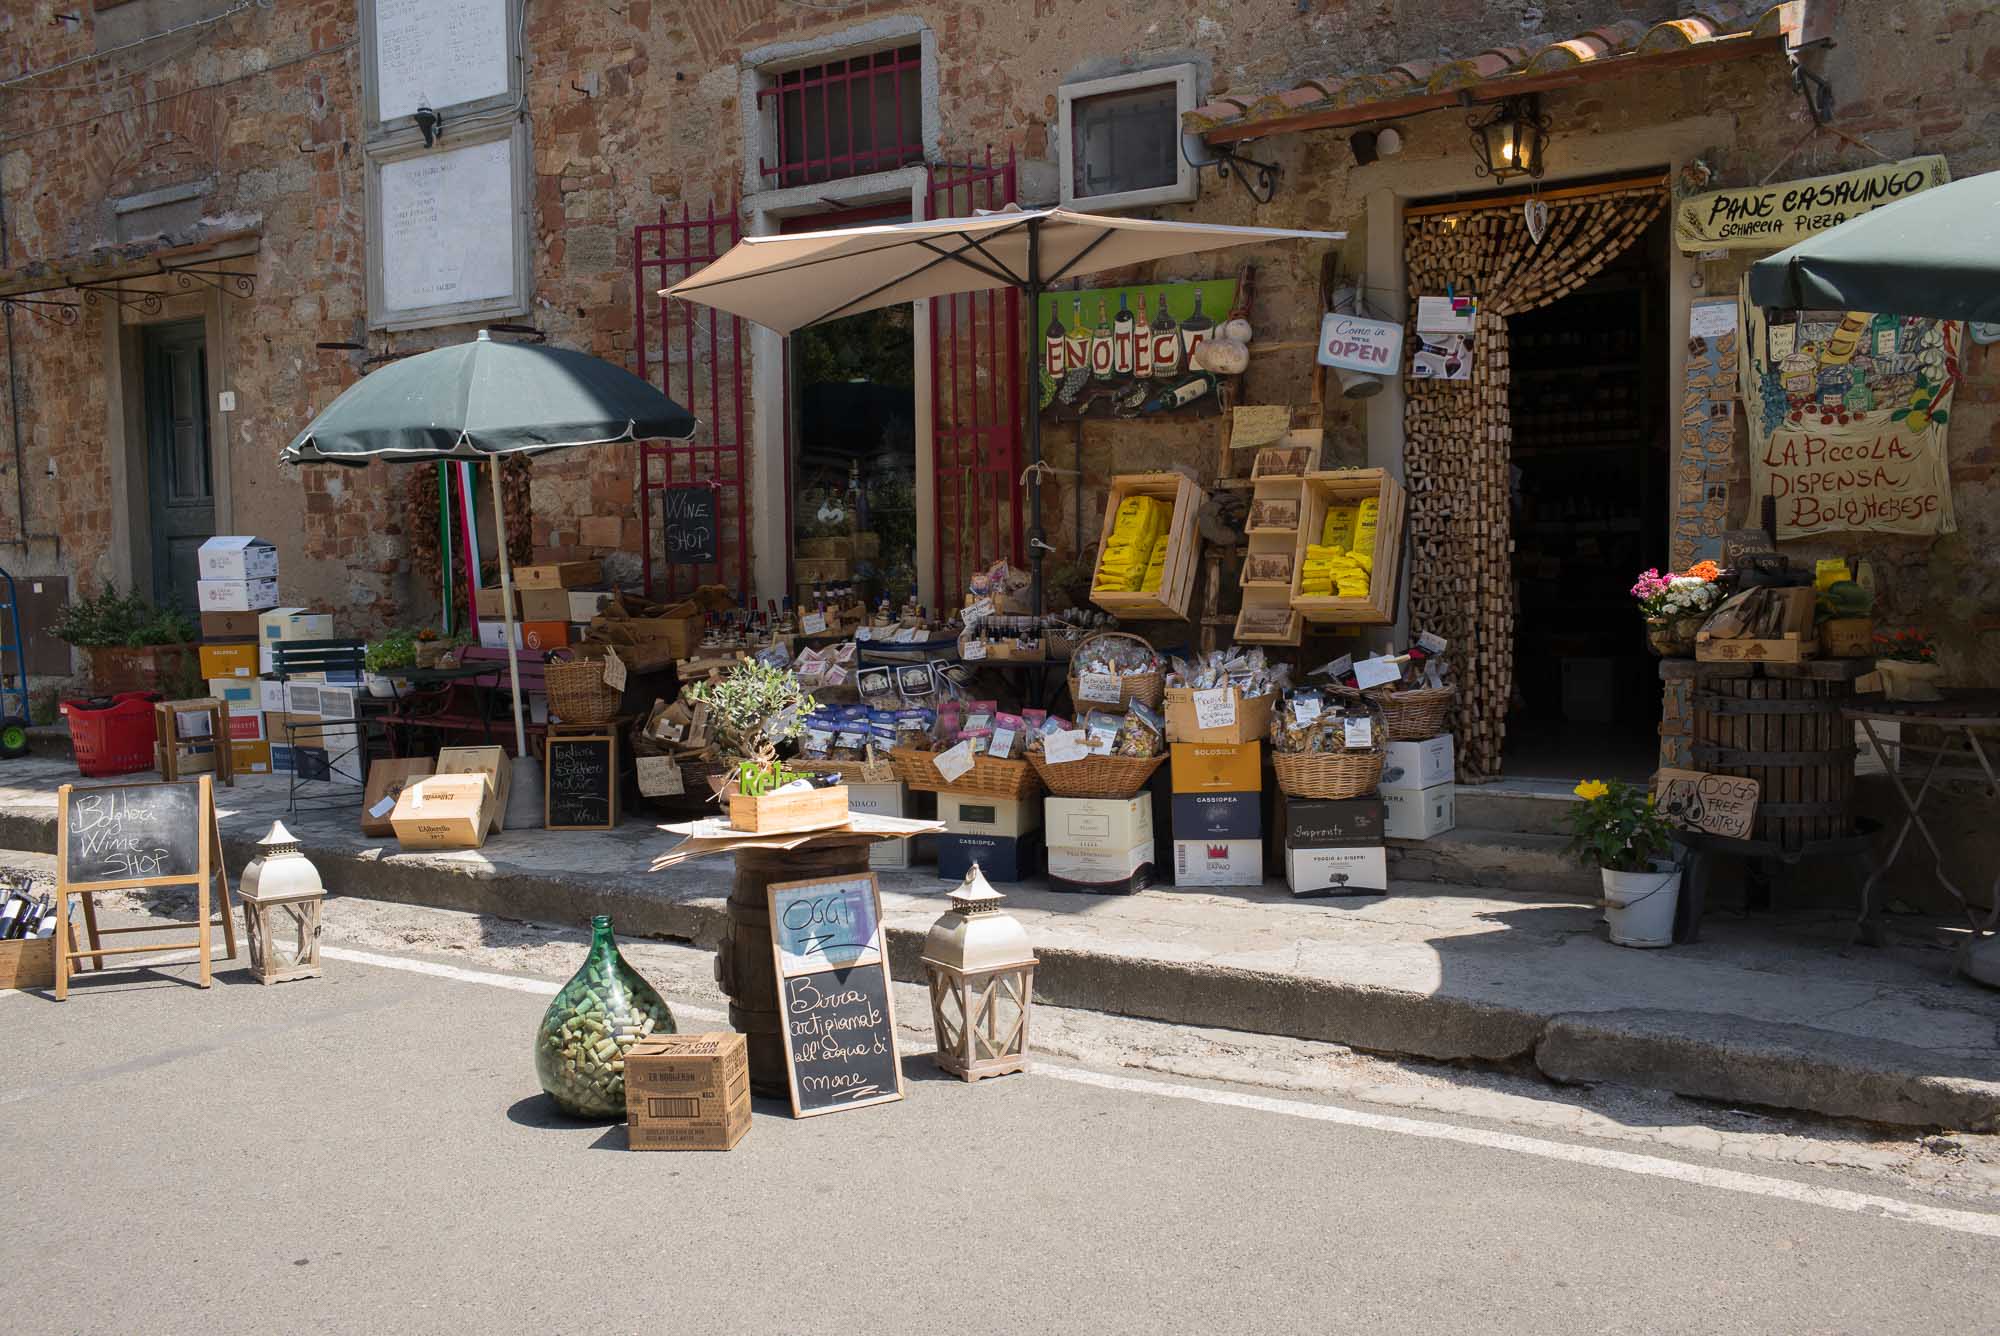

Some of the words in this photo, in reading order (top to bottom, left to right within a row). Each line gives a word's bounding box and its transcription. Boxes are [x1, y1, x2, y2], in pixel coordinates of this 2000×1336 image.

[1708, 192, 1776, 226] PANE
[1782, 170, 1925, 213] CASALINGO
[1719, 219, 1784, 238] SCHIACCIA
[1795, 211, 1847, 232] PIZZA
[1374, 325, 1387, 336] in
[1328, 340, 1389, 364] OPEN
[1762, 434, 1798, 468] LA
[1769, 465, 1900, 499] DISPENSA
[666, 523, 710, 551] SHOP
[1700, 777, 1757, 800] DOGS
[850, 800, 878, 808] NDACO
[1704, 799, 1744, 814] FREE
[1702, 815, 1745, 836] ENTRY
[959, 838, 996, 846] CASSIOPEA
[101, 847, 169, 876] SHOP
[790, 976, 867, 1014] Birra
[790, 1000, 882, 1051] artigianale
[694, 1041, 720, 1049] CON
[874, 1031, 887, 1055] di
[802, 1073, 868, 1093] mare
